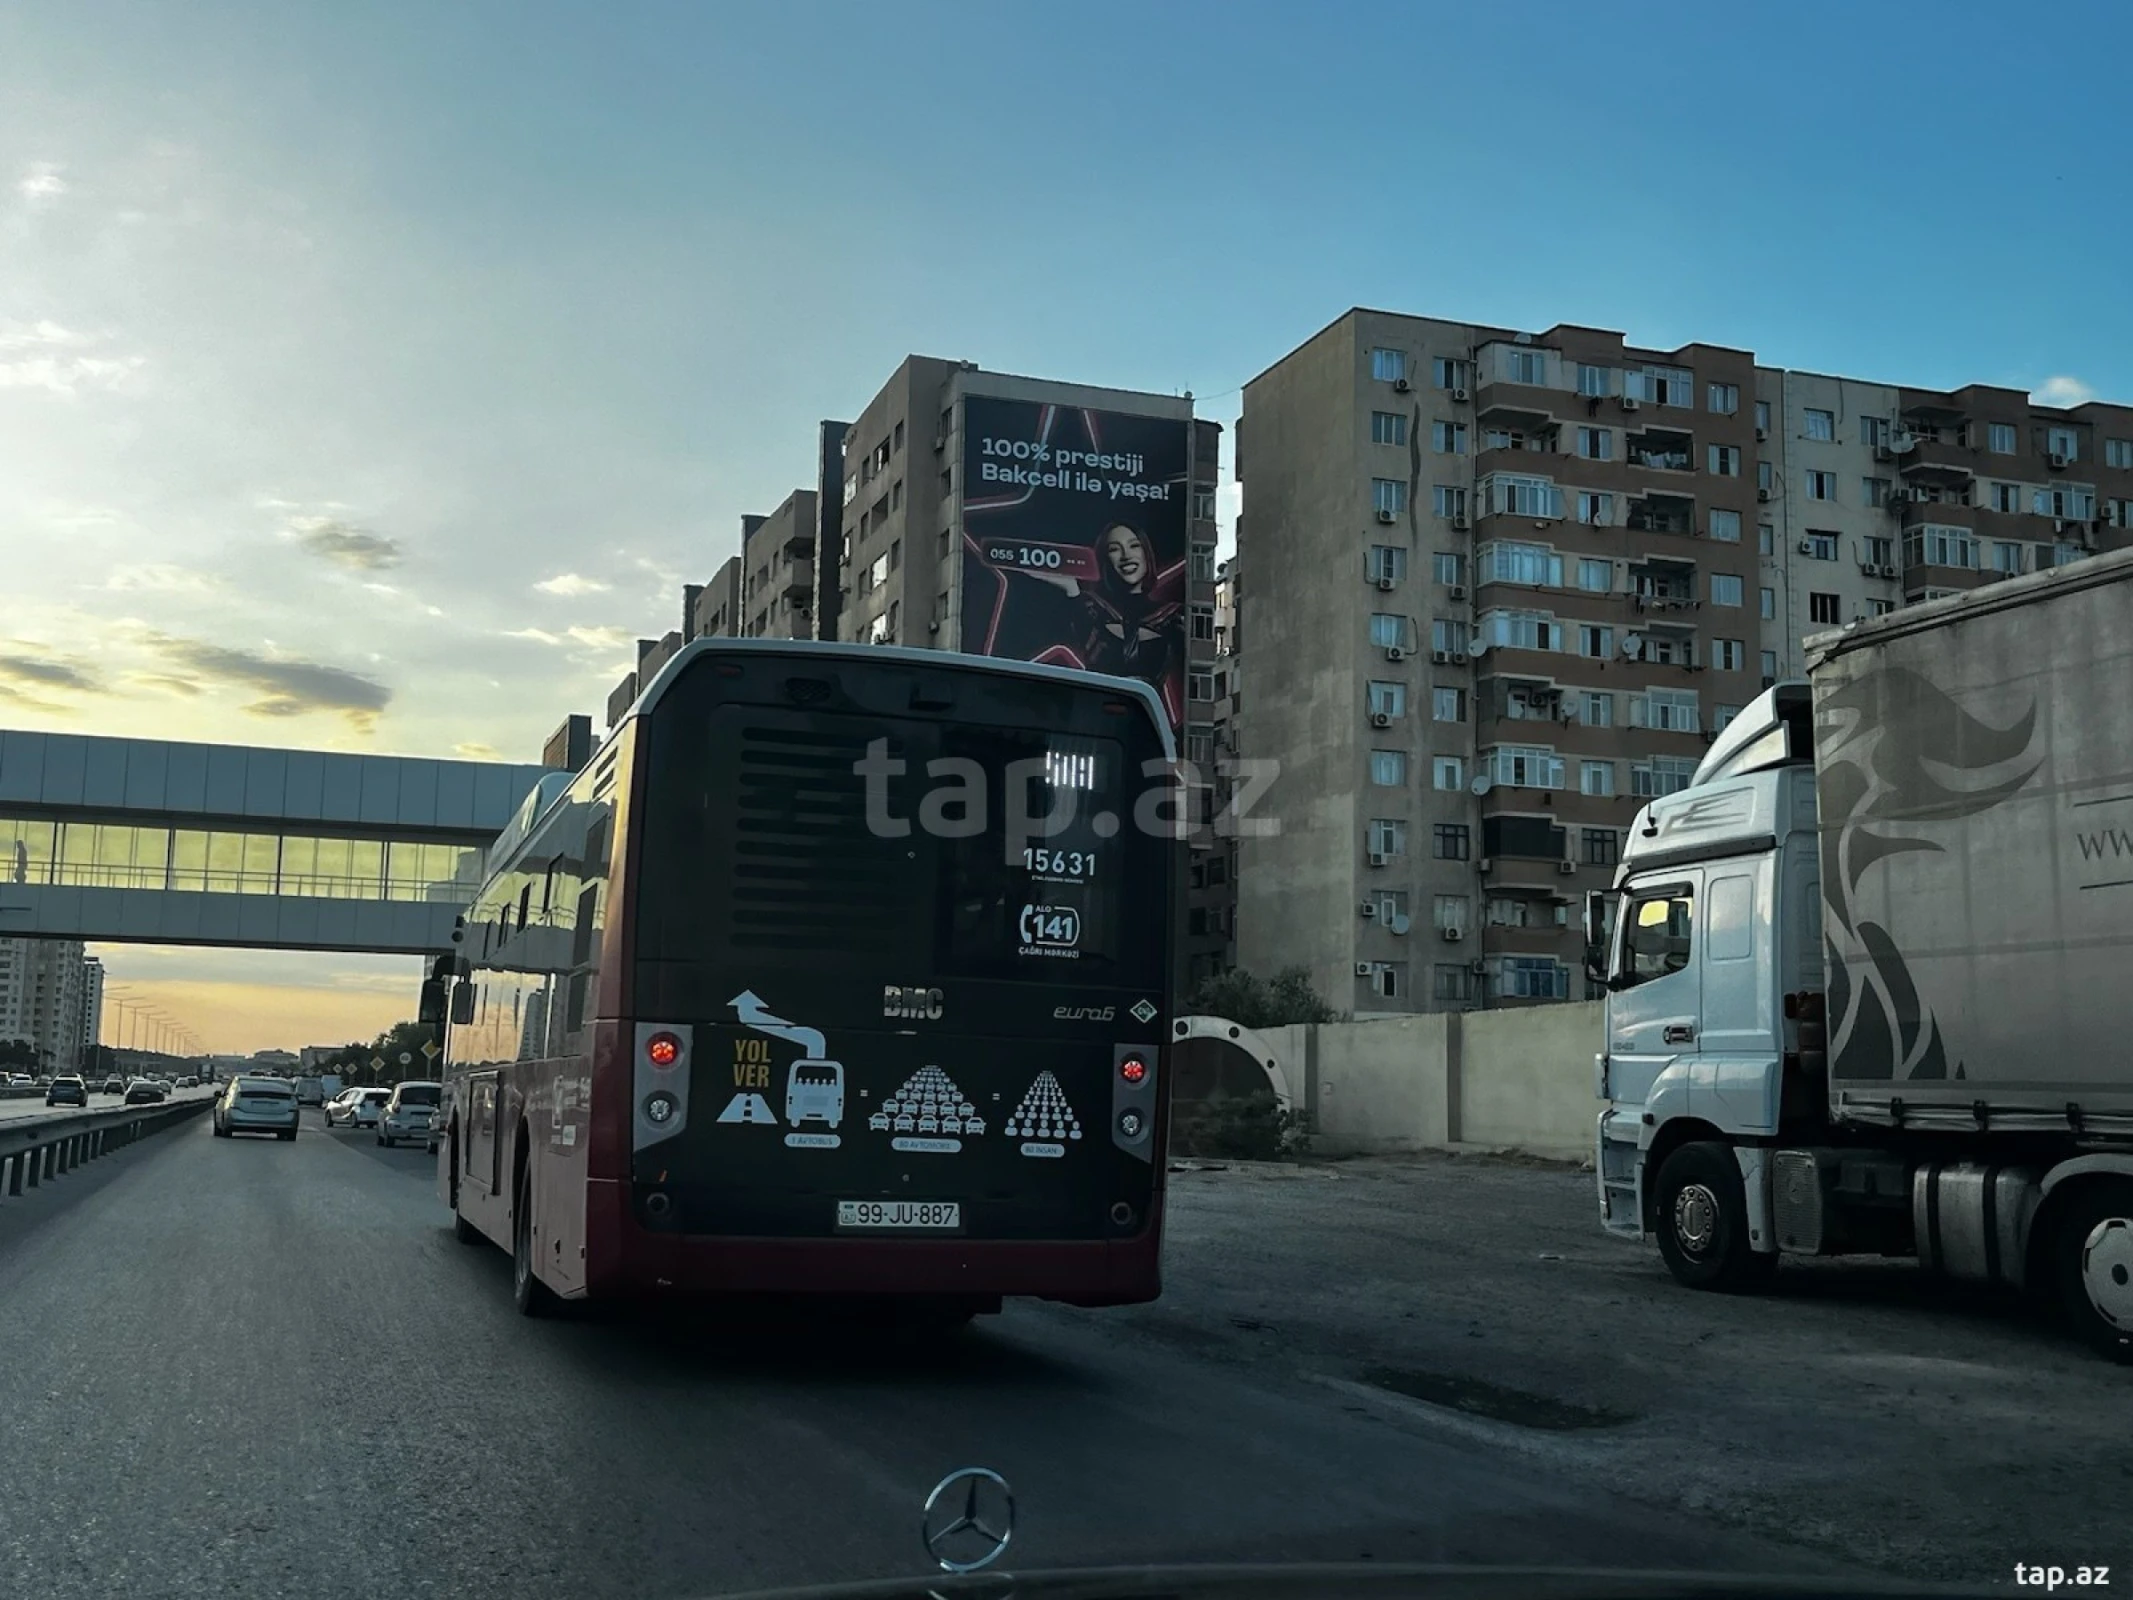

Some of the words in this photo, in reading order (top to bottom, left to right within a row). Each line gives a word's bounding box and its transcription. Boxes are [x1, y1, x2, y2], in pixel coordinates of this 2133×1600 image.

[982, 438, 1050, 462] 100%
[1056, 449, 1143, 476] prestiji
[982, 463, 1070, 490] Bakcell
[1076, 472, 1101, 492] ilə
[1108, 480, 1169, 502] yaşa!
[1020, 547, 1061, 568] 100
[1023, 848, 1095, 876] 15631
[1033, 914, 1073, 940] 141
[884, 985, 944, 1020] BMC
[735, 1040, 772, 1063] YOL
[733, 1063, 769, 1088] VER
